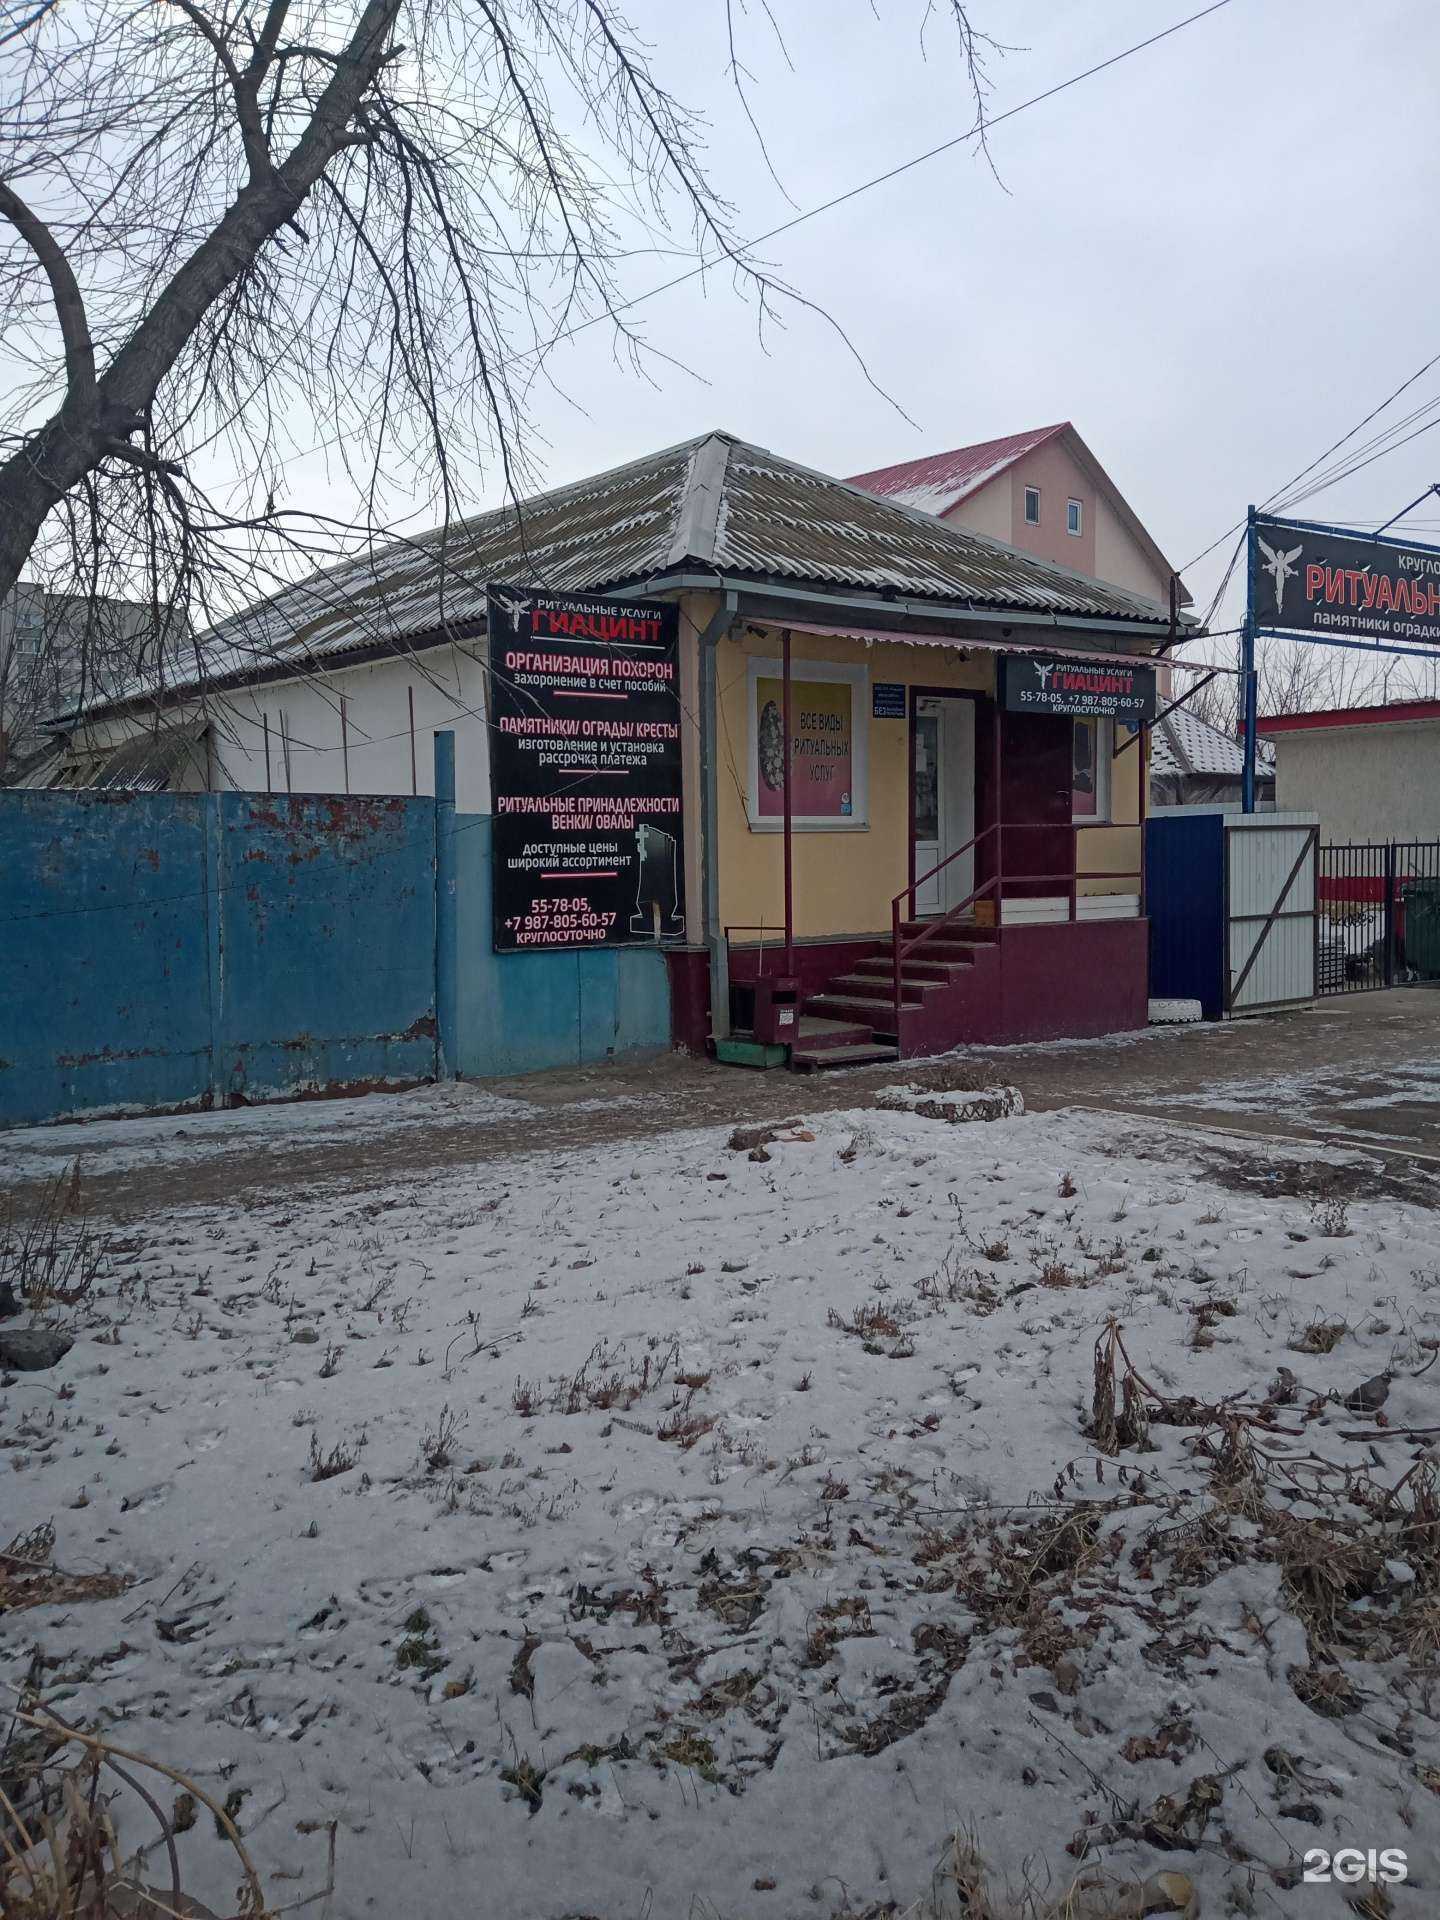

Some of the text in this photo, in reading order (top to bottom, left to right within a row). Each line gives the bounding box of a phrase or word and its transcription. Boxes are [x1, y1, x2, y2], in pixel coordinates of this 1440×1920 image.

[537, 599, 661, 620] РИТУАЛЬНЫЕ УСЛУГИ
[531, 610, 662, 641] ГИАЦИНТ
[1314, 612, 1390, 632] памятники
[506, 652, 673, 679] ОРГАНИЗАЦИЯ ПОХОРОН
[1056, 663, 1133, 678] РИТУАЛЬНЫЕ УСЛУГИ
[514, 673, 666, 692] захоронение в счет пособий
[1052, 672, 1134, 693] ГИАЦИНТ
[1020, 691, 1144, 708] 55-78-05, +7 987-805-60-57
[1053, 704, 1115, 715] КРУГЛОСУТОЧНО
[500, 717, 677, 739] ПАМЯТНИКИ/ ОГРАДЫ/ КРЕСТЫ
[800, 712, 842, 733] ВСЕ ВИДЫ
[518, 738, 664, 754] изготовление и установка
[794, 738, 848, 756] РИТУАЛЬНЫХ
[539, 753, 647, 766] рассрочка платежа
[809, 764, 835, 783] УСЛУГ
[498, 797, 679, 814] РИТУАЛЬНЫЕ ПРИНАДЛЕЖНОСТИ
[552, 815, 634, 830] ВЕНКИ/ ОВАЛЫ
[589, 843, 617, 853] цены
[508, 855, 631, 870] широкий ассортимент
[532, 898, 592, 913] 55-78-05,
[505, 912, 617, 930] +7 987-805-60-57
[517, 928, 606, 943] КРУГЛОСУТОЧНО
